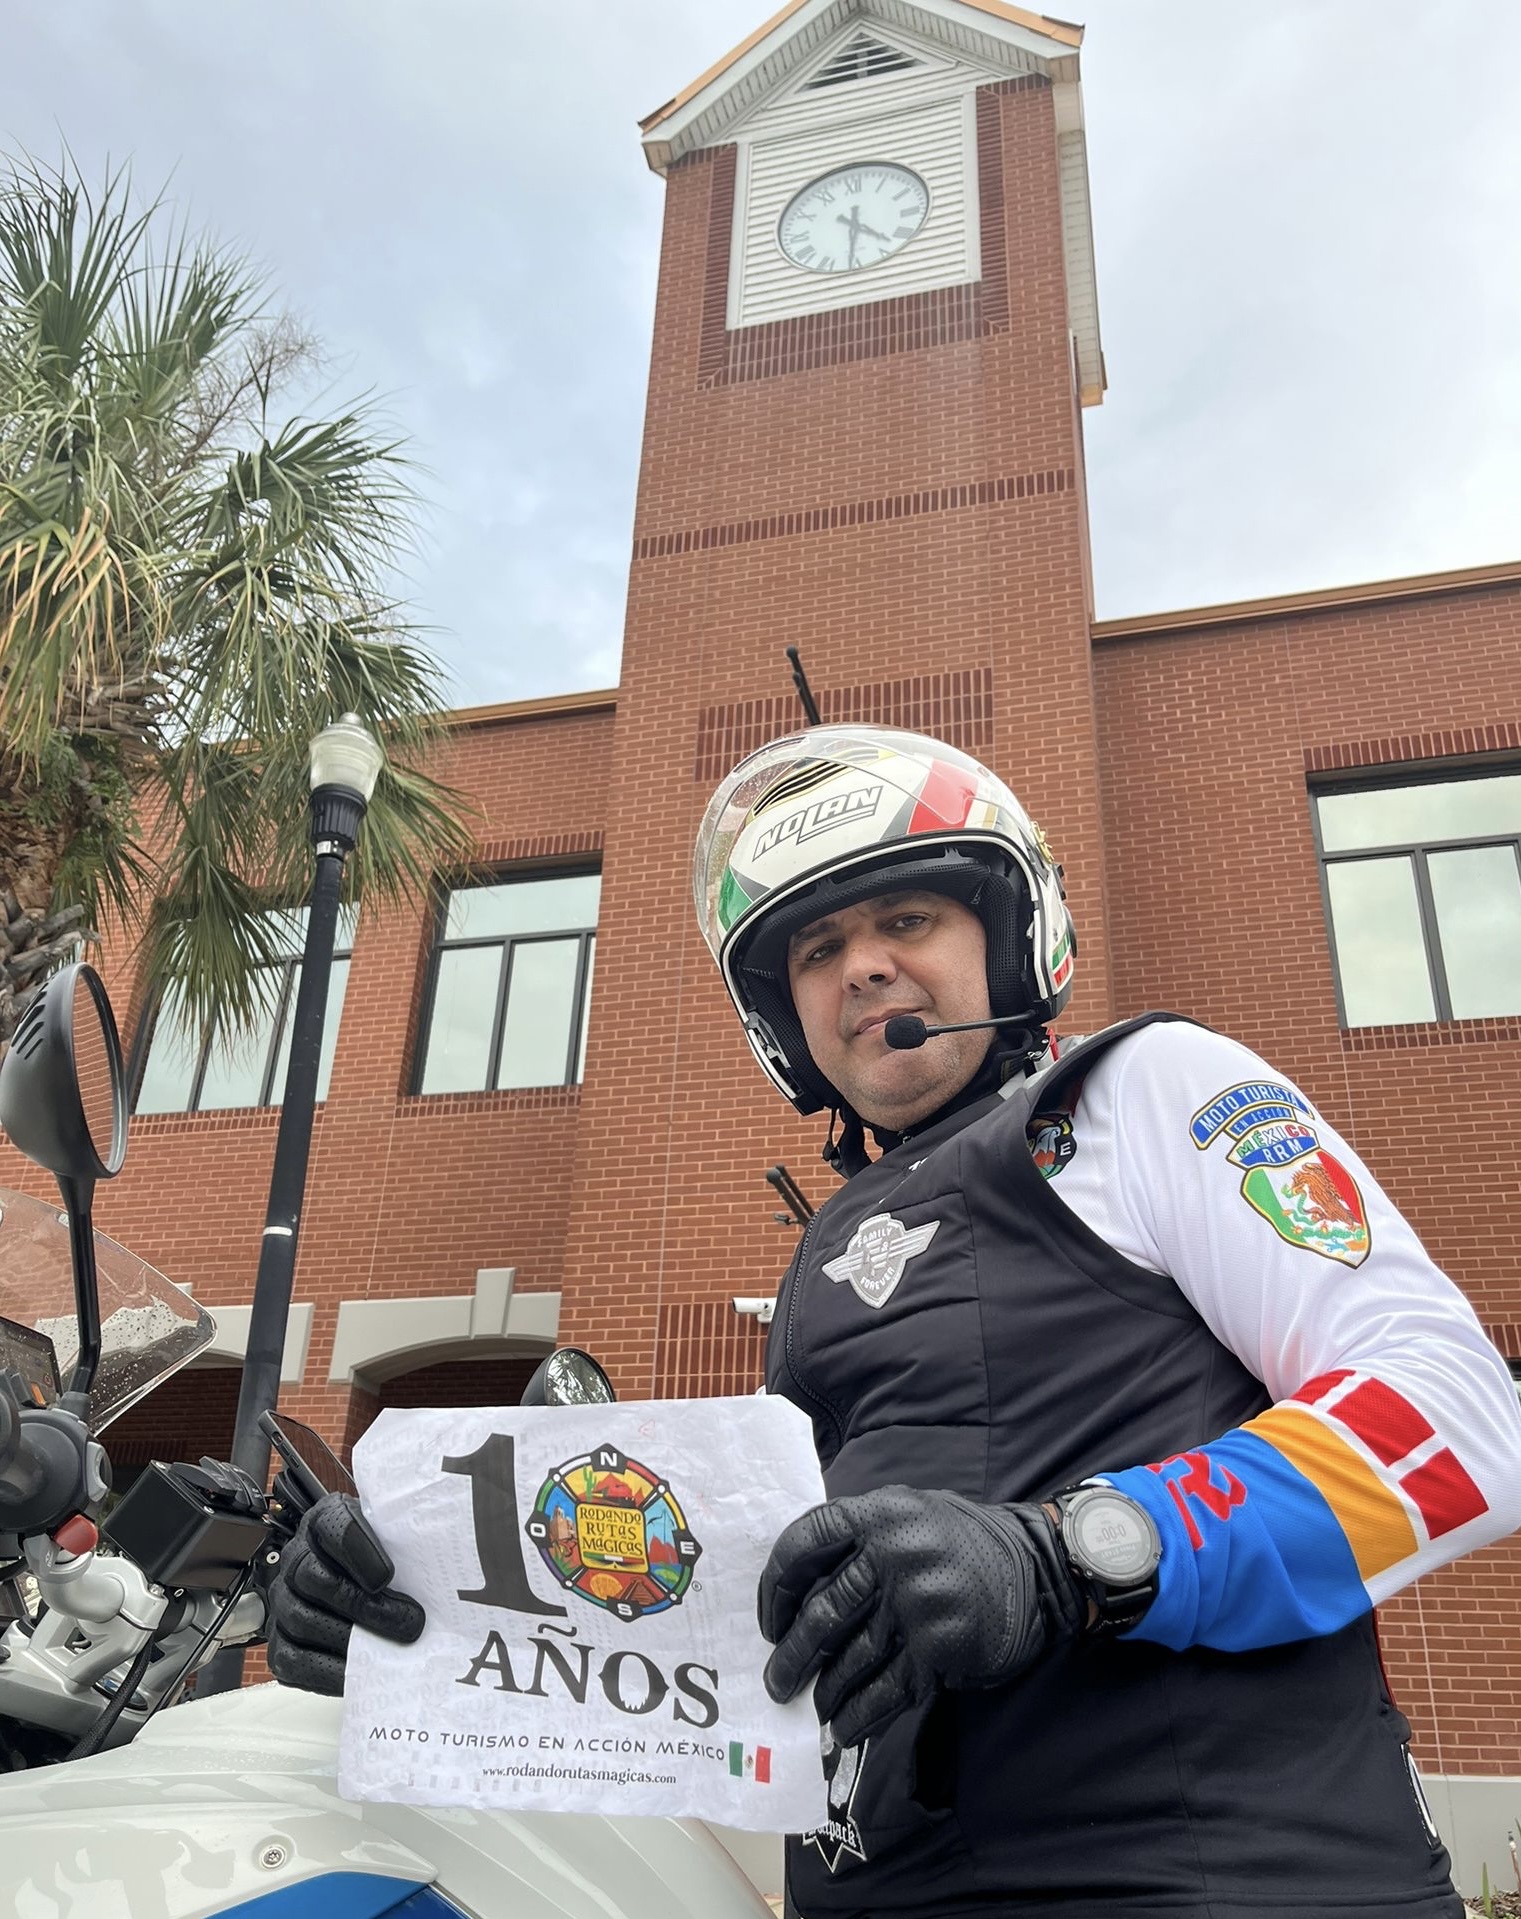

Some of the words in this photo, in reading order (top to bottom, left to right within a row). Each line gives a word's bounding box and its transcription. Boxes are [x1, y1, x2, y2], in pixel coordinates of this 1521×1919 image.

[752, 785, 884, 863] NOLAN
[1199, 1094, 1240, 1133] MOTO
[1238, 1085, 1300, 1109] TURISTA
[1236, 1118, 1248, 1133] EN
[1060, 1141, 1072, 1157] E
[1262, 1139, 1305, 1164] RRM
[857, 1226, 893, 1248] FAMILY
[860, 1265, 896, 1291] FOREVER
[600, 1451, 618, 1468] N
[680, 1540, 696, 1556] E
[616, 1602, 634, 1617] S
[454, 1623, 720, 1729] AÑOS
[369, 1726, 430, 1743] MOTO
[440, 1732, 529, 1749] TURISMO
[538, 1735, 565, 1750] EN
[574, 1736, 647, 1754] ACCIÓN
[655, 1738, 726, 1762] MÉXICO
[482, 1762, 677, 1786] www.rodandorutasmagicas.com
